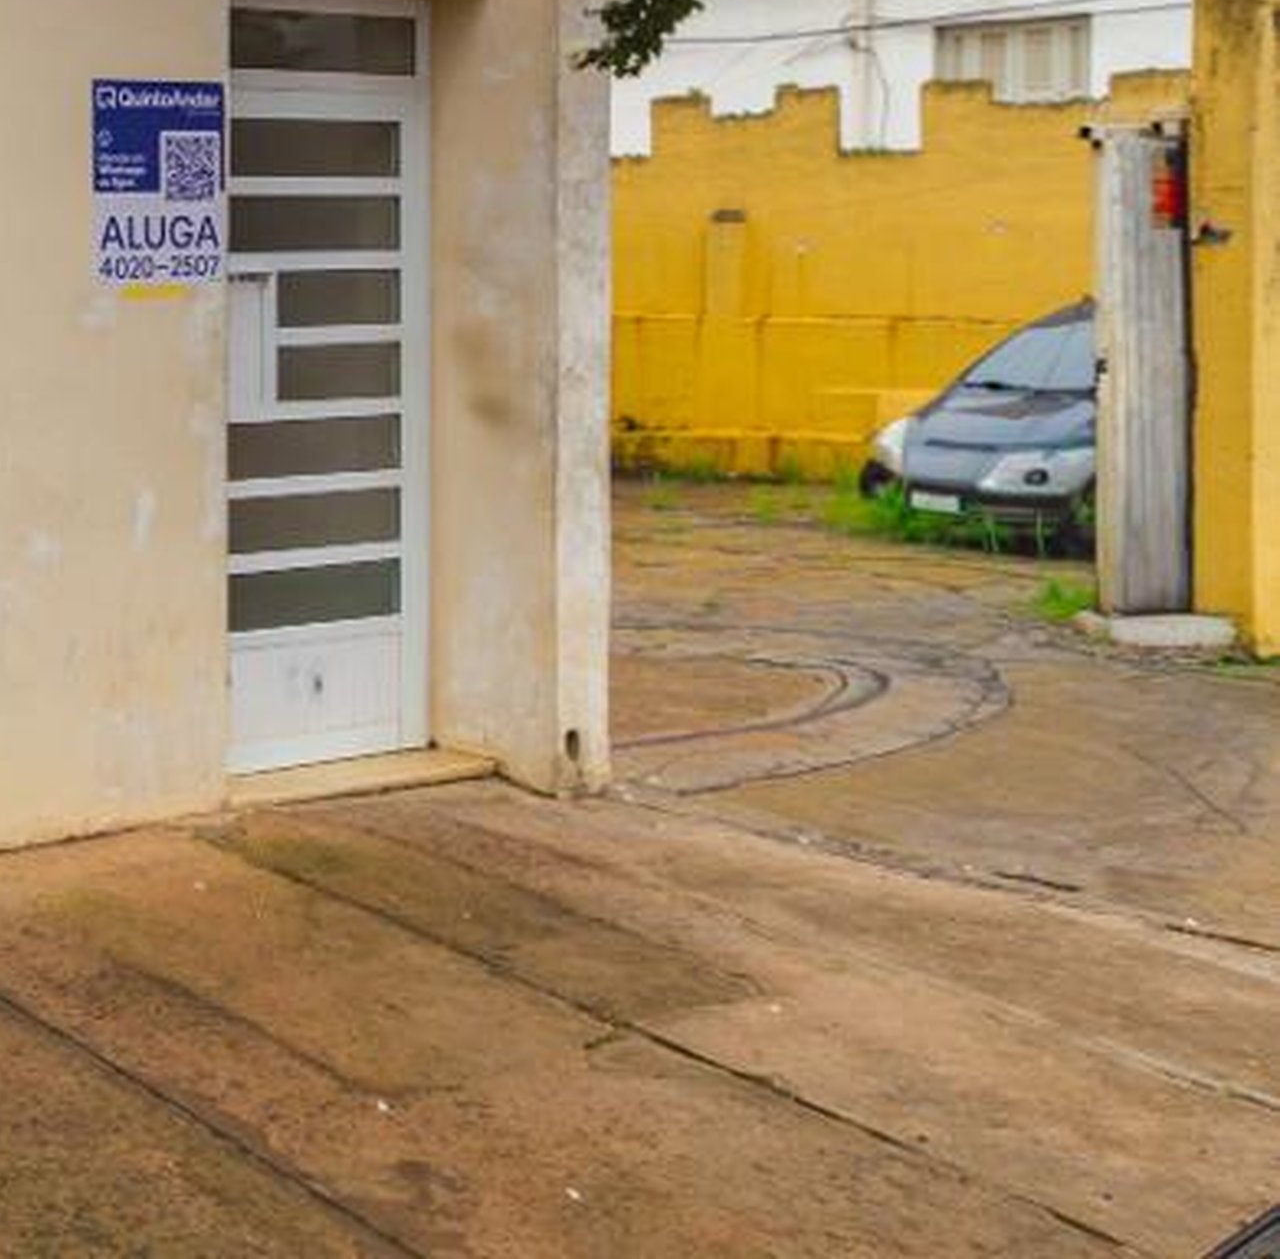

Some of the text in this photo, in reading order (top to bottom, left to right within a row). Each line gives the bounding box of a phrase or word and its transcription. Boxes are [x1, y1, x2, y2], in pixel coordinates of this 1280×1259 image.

[118, 89, 221, 109] QuintoAndar
[100, 215, 220, 251] ALUGA
[98, 254, 221, 280] 4020-2507
